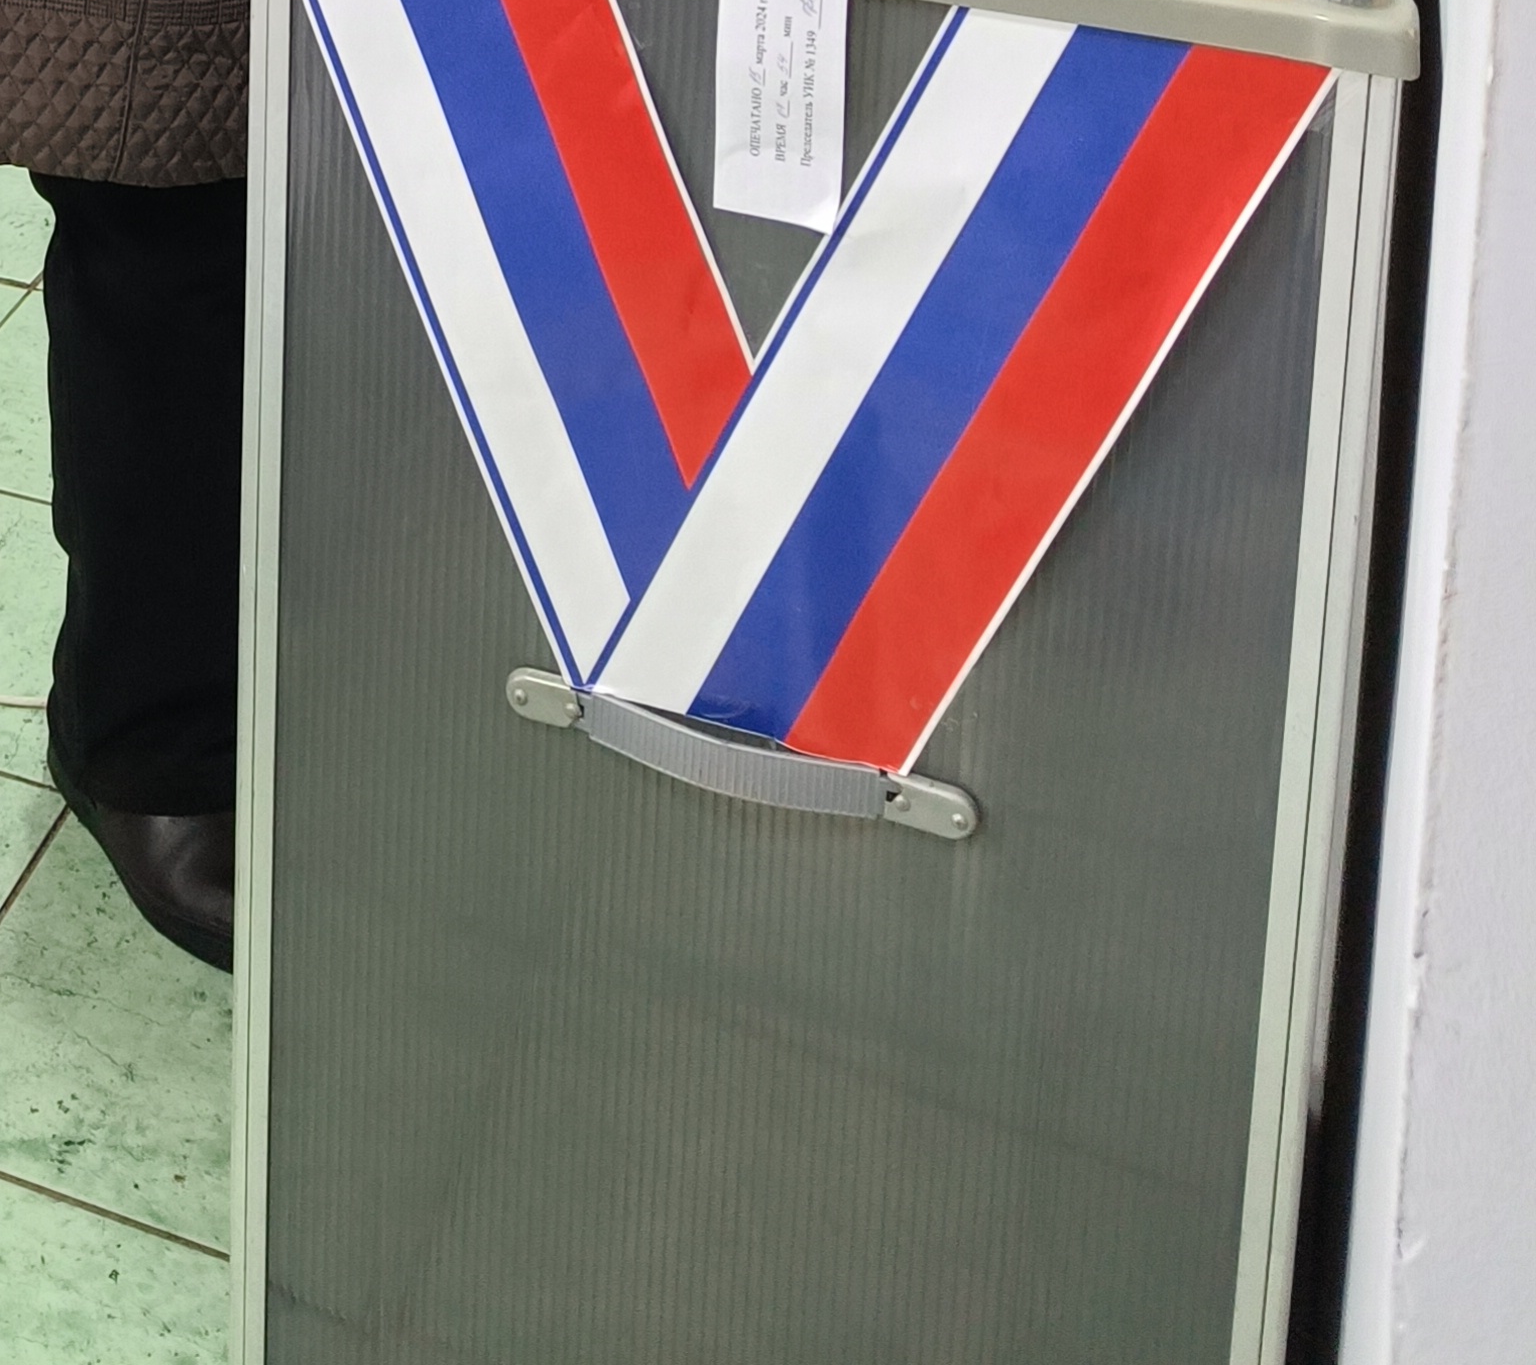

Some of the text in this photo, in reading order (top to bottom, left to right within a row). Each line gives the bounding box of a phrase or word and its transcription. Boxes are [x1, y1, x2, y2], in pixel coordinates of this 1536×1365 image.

[755, 5, 767, 31] 2024
[755, 34, 767, 65] марта
[805, 30, 817, 56] 1349
[780, 79, 788, 97] час
[802, 72, 815, 98] УИК
[749, 87, 762, 157] ОПЕЧАТАНО
[799, 101, 815, 167] Председатель
[774, 122, 787, 162] ВРЕМЯ
